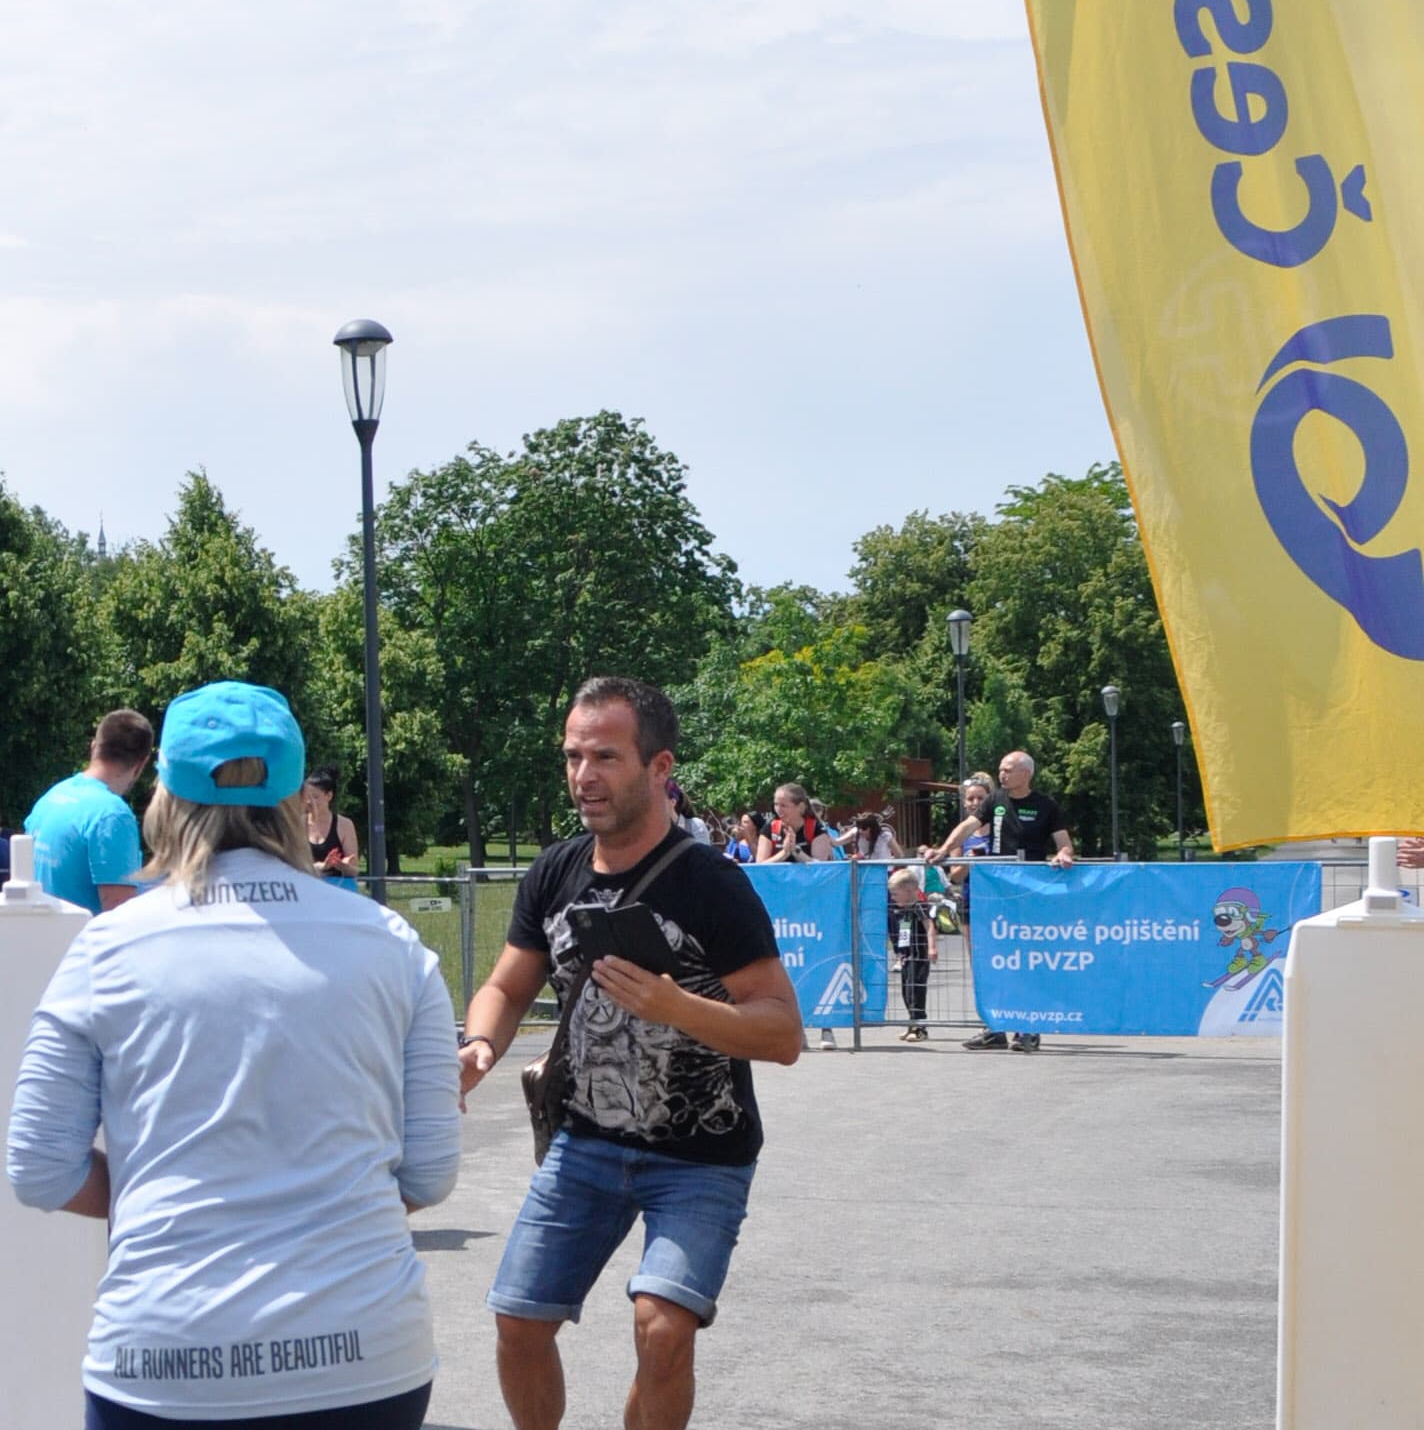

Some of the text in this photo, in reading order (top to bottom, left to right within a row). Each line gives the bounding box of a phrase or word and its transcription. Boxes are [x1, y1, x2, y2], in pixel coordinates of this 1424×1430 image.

[990, 915, 1201, 946] Úrazové pojištění
[991, 950, 1095, 971] od PVZP
[991, 1008, 1083, 1022] www.pvzp.cz
[114, 1329, 365, 1380] ALL RUNNERS ARE BEAUTIFUL
